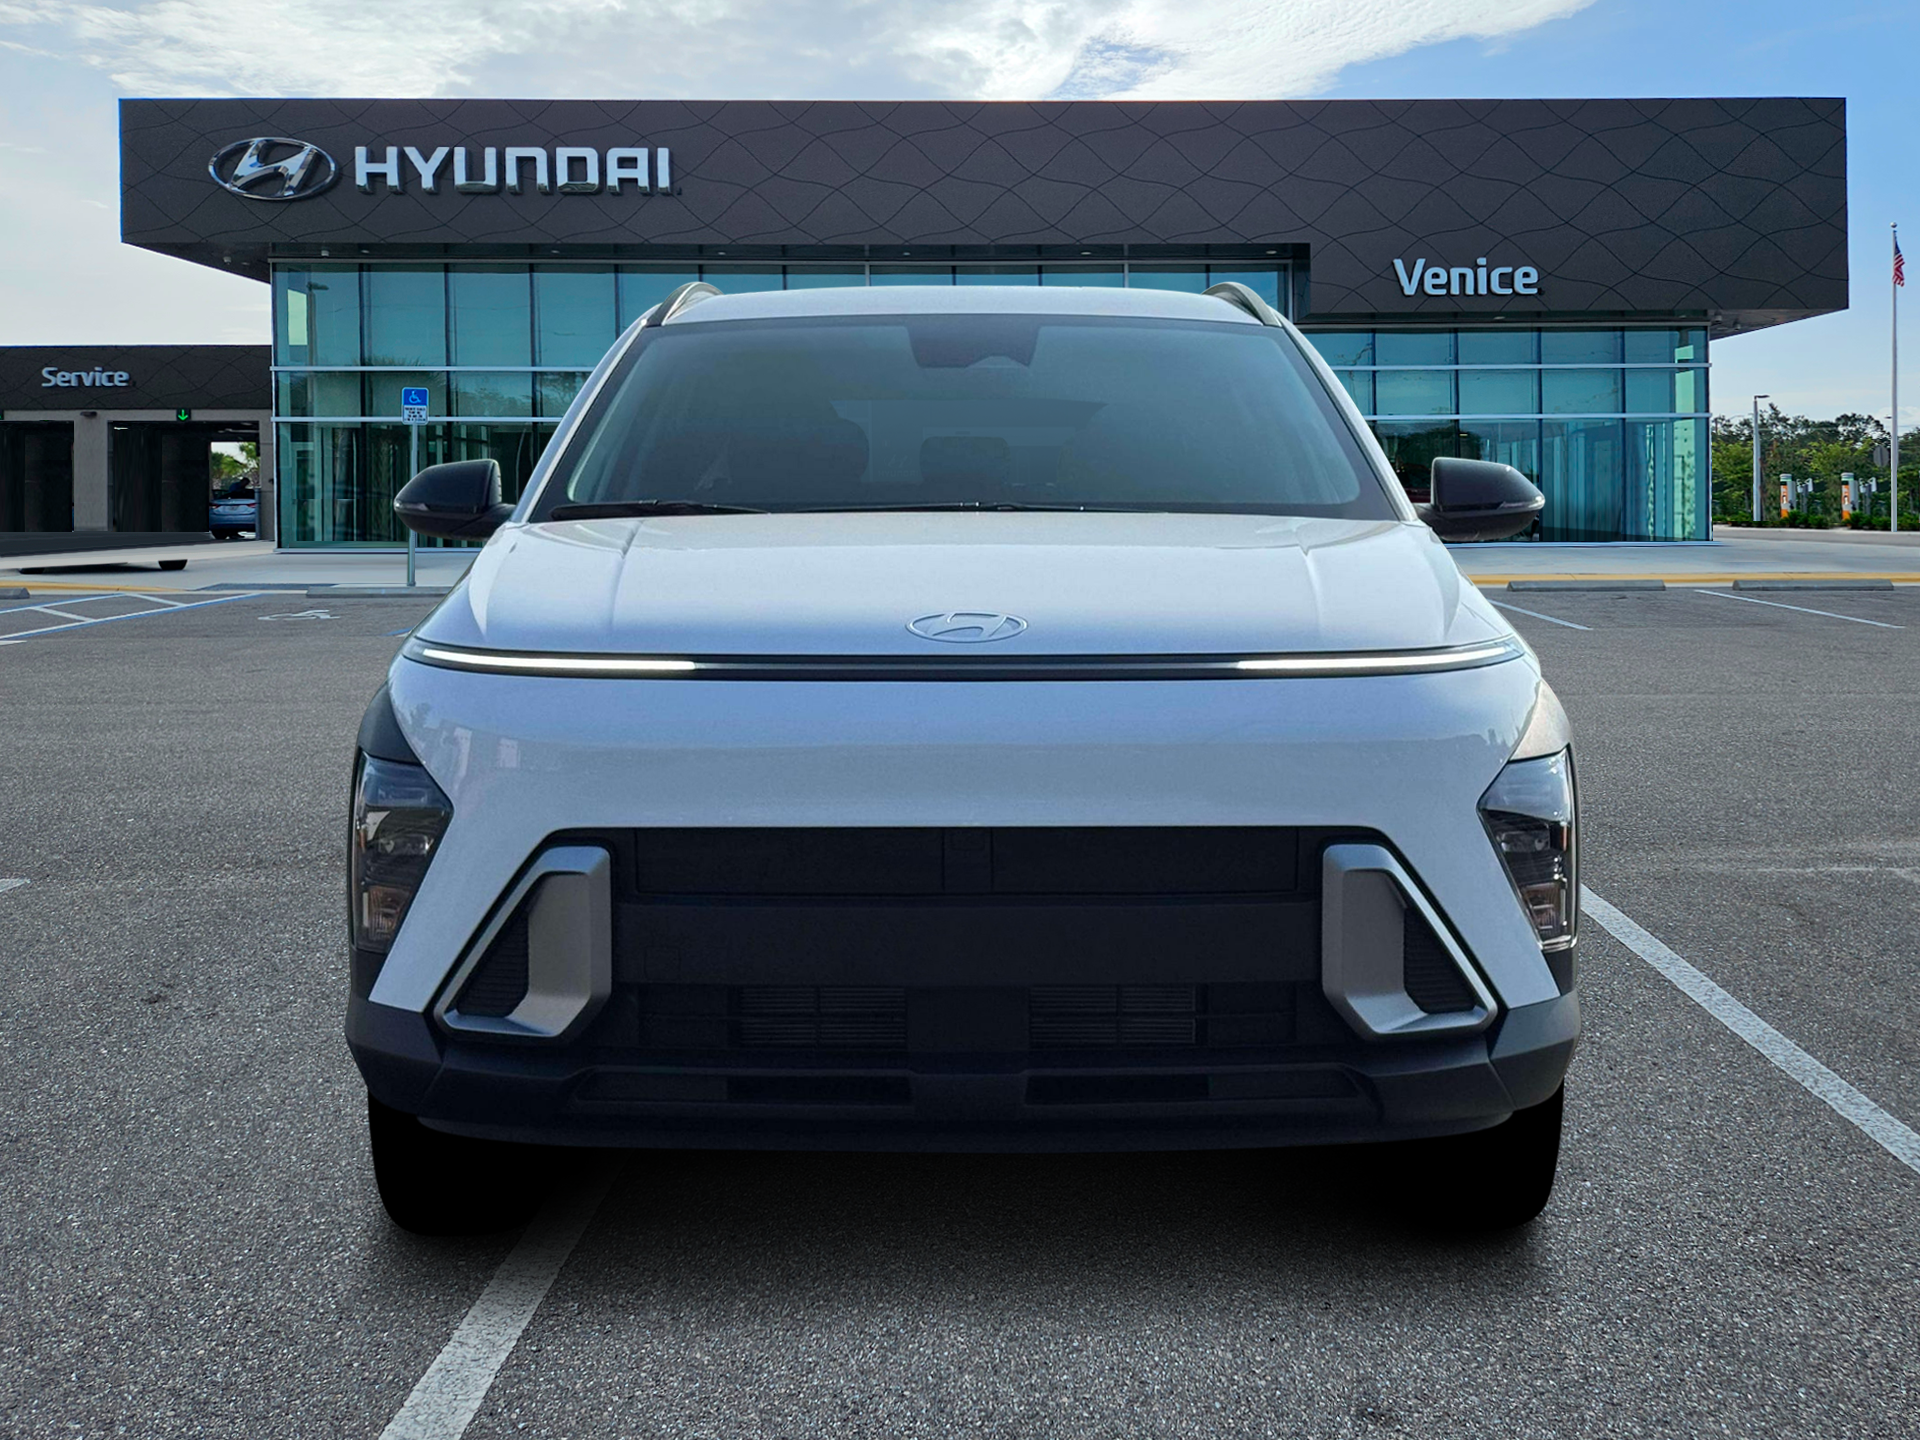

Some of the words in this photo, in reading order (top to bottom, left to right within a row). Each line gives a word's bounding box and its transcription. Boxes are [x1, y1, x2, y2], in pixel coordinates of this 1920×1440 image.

[354, 146, 670, 194] HYUNDAI
[1393, 257, 1539, 295] Venice
[41, 366, 130, 387] Service
